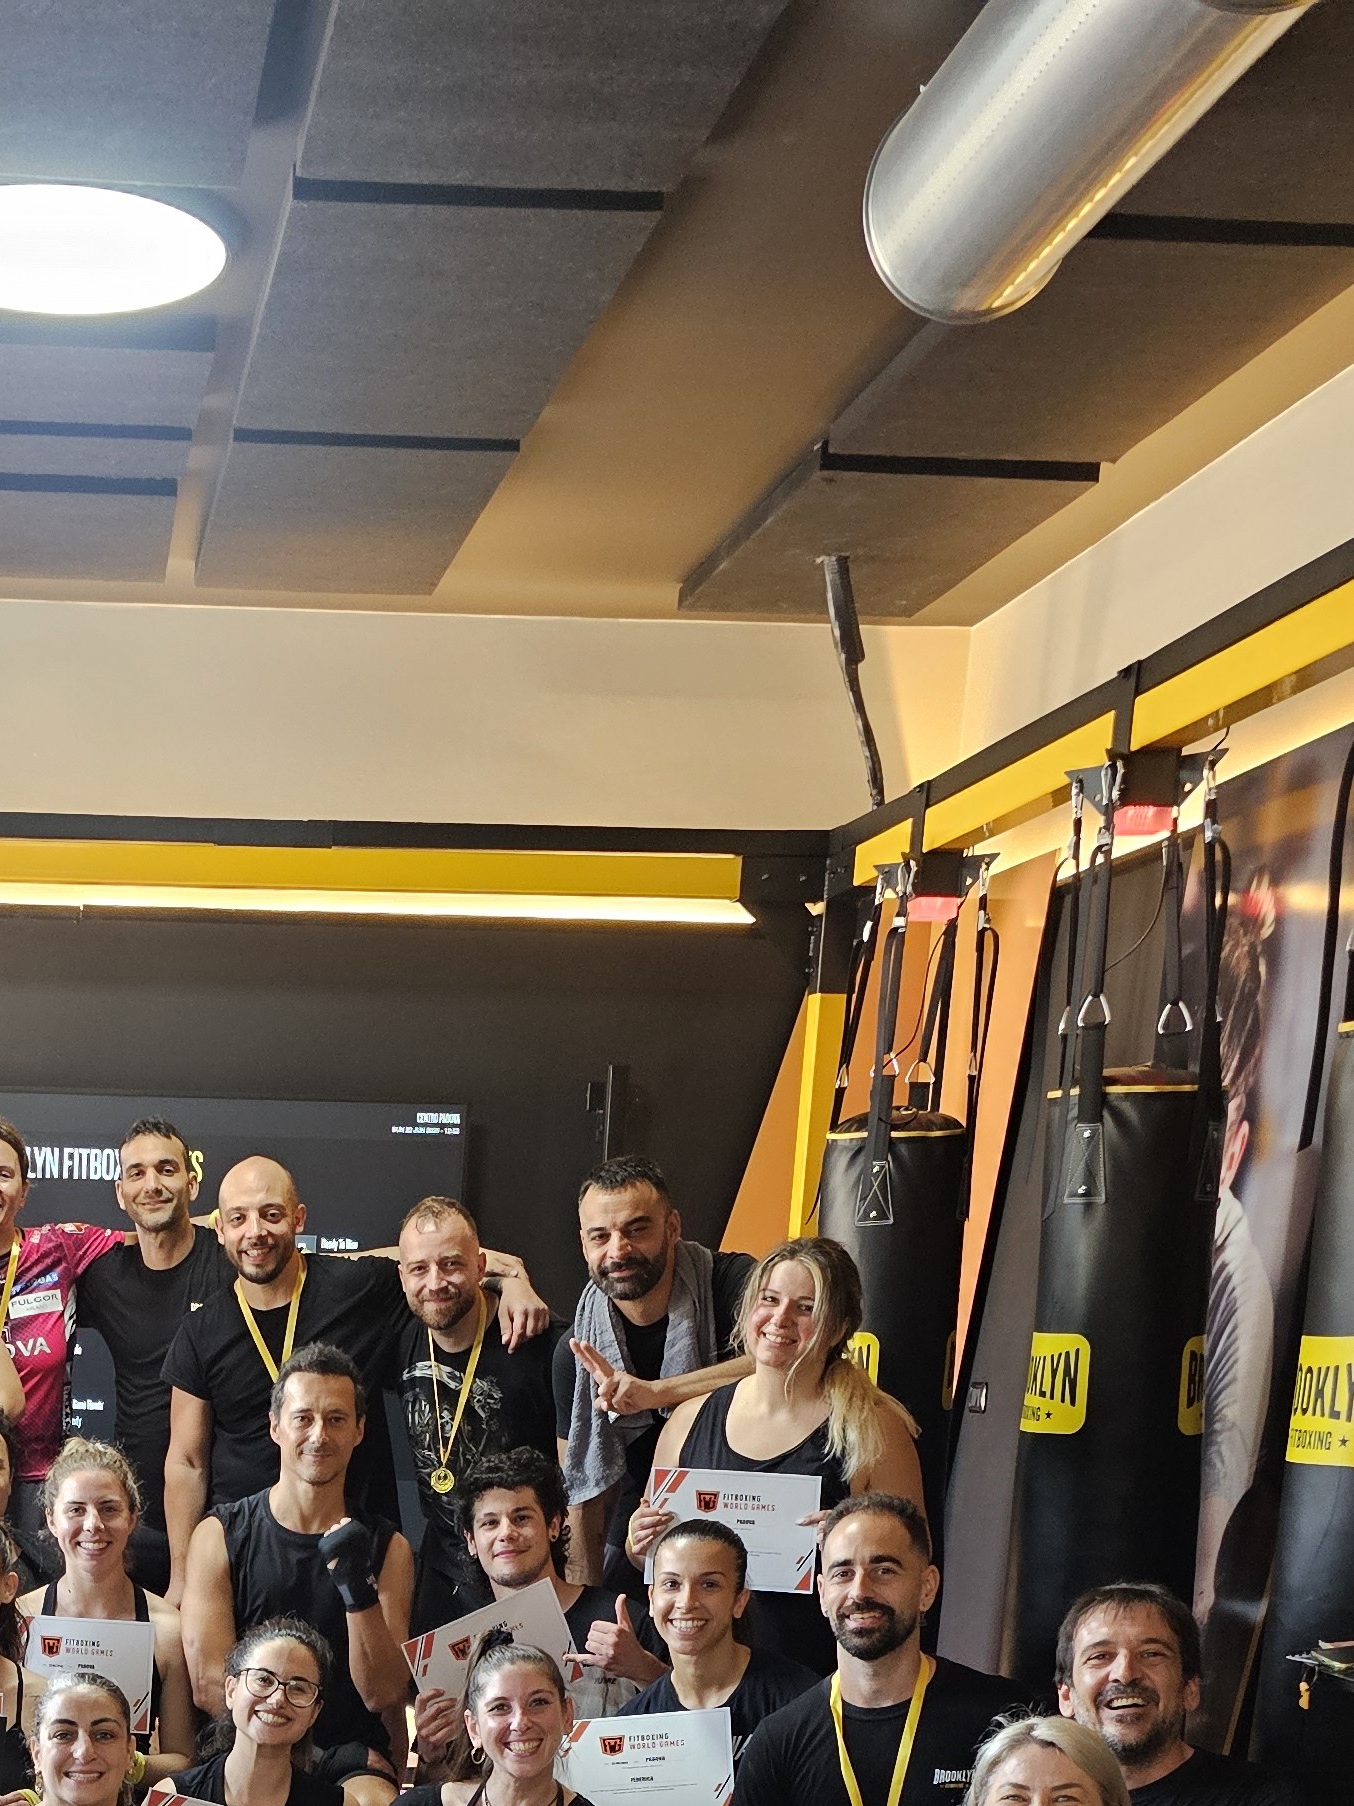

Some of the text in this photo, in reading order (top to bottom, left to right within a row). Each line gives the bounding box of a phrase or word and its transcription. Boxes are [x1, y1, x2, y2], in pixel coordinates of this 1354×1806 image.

[11, 1294, 59, 1308] FULGOR
[723, 1493, 761, 1503] FITBOXING
[723, 1502, 776, 1513] WORLD GAMES
[65, 1638, 100, 1647] FITBOXING
[66, 1648, 88, 1656] WORLD
[628, 1732, 669, 1742] FITBOXING
[628, 1739, 685, 1750] WORLD GAMES
